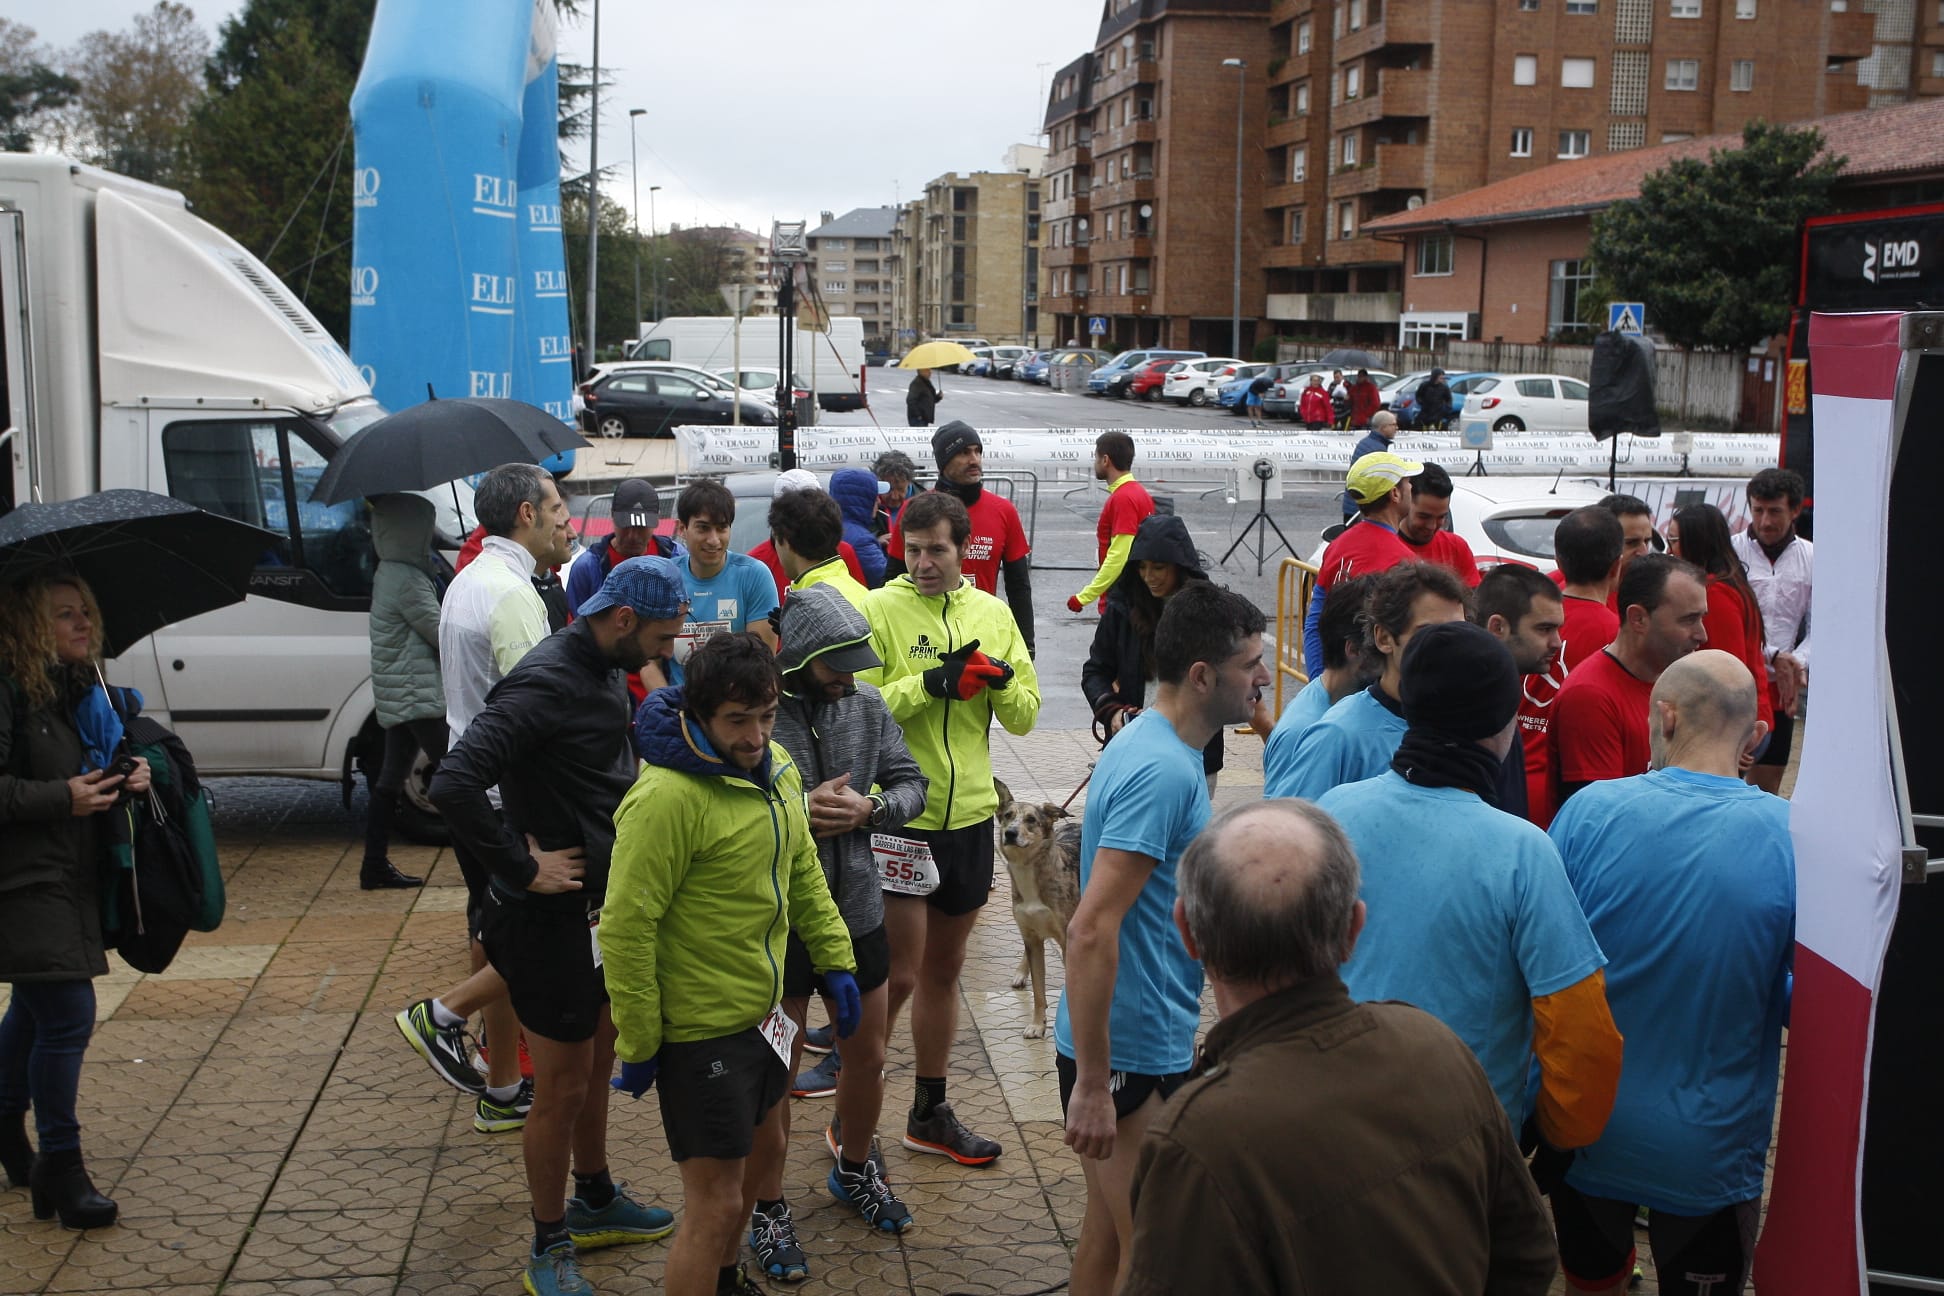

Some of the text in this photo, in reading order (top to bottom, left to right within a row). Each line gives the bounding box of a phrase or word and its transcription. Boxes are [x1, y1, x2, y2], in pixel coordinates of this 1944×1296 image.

[1883, 240, 1919, 267] EMD
[910, 646, 938, 654] SPRINT
[1517, 714, 1546, 725] WHERE
